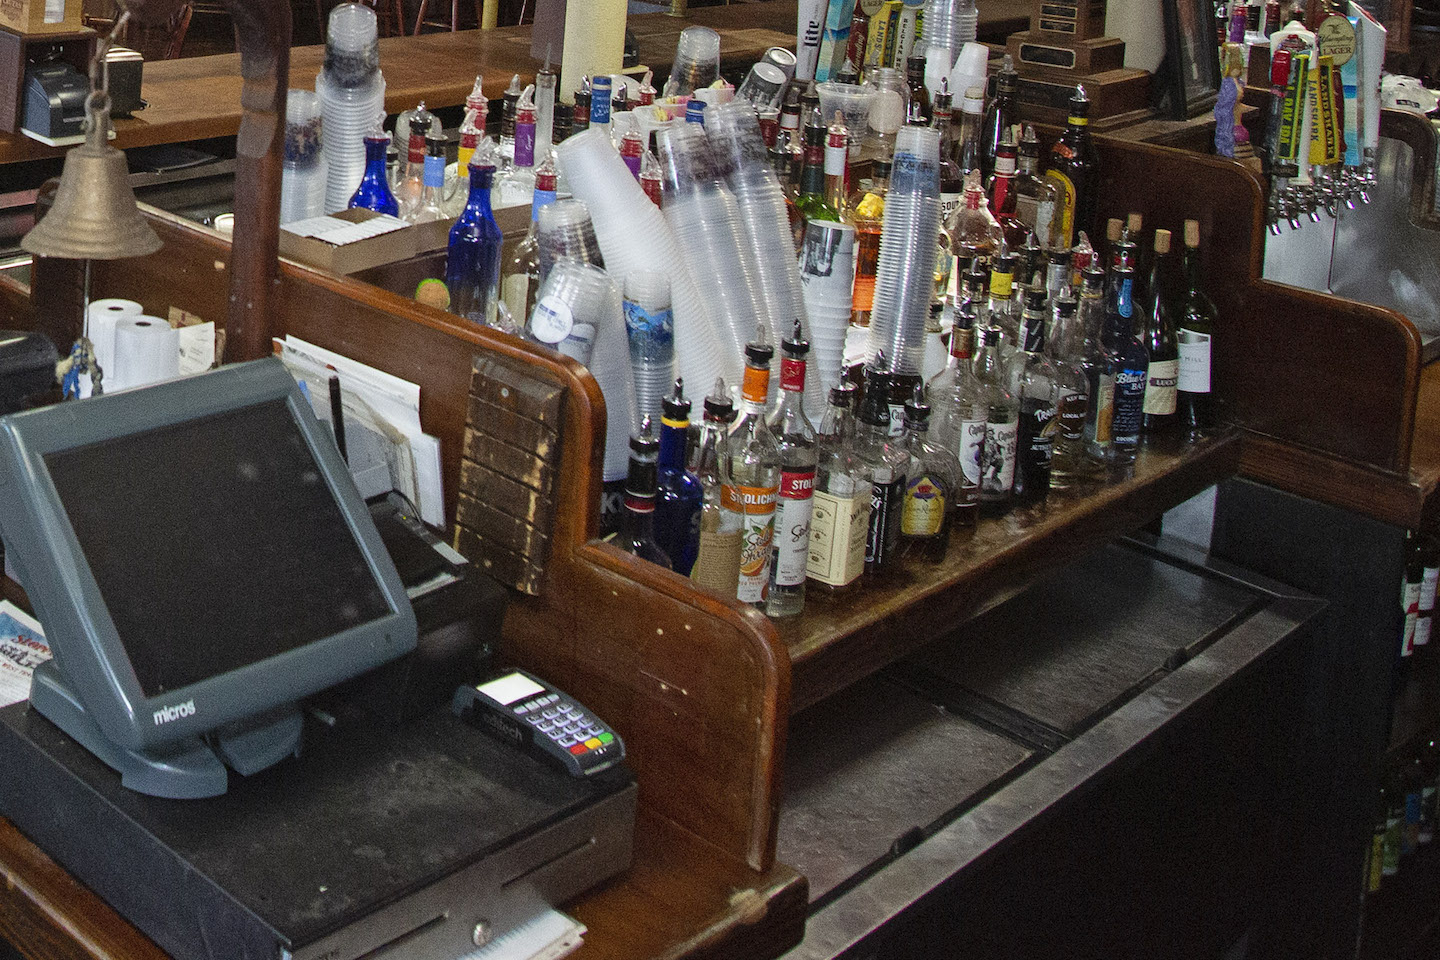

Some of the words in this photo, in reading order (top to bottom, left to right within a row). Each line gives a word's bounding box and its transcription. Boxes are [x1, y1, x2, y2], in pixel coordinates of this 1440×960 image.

[804, 20, 820, 48] lite
[1322, 46, 1353, 57] LAGER
[152, 698, 197, 727] micros
